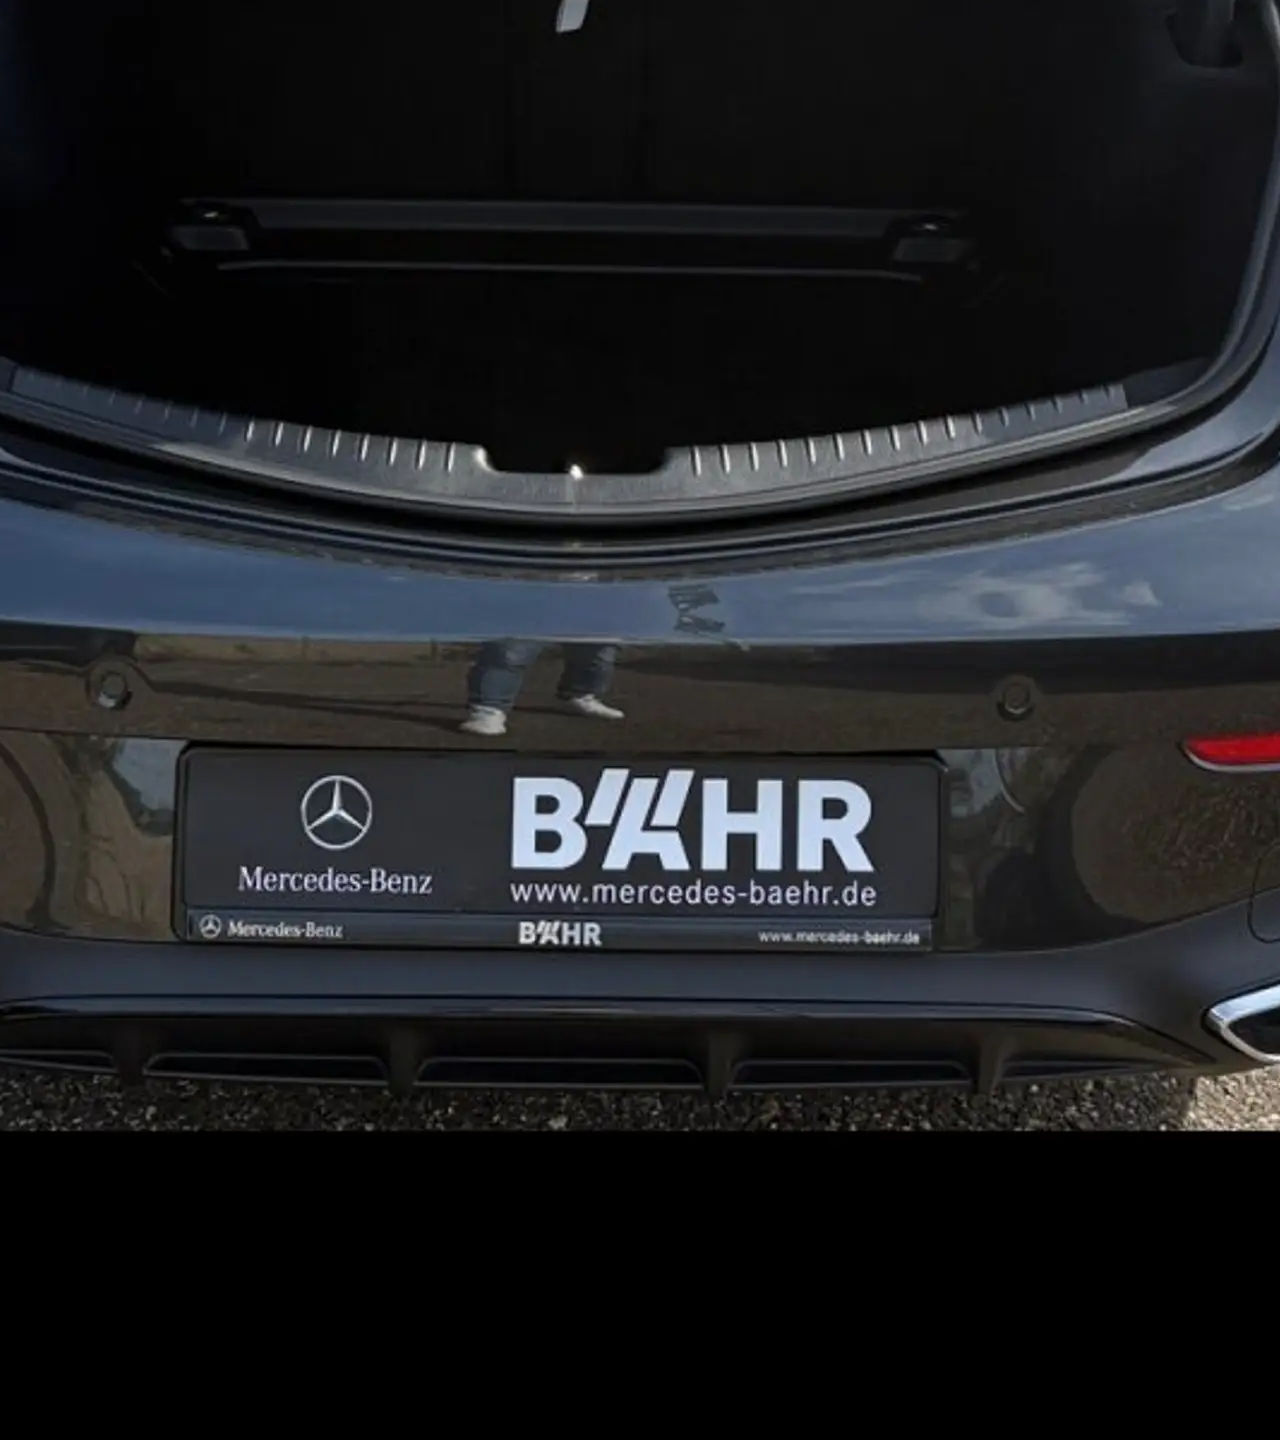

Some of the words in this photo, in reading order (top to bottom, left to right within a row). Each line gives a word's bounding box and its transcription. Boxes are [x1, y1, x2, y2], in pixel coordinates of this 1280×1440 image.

[511, 768, 875, 873] BÄHR
[237, 866, 433, 895] Mercedes-Benz
[510, 879, 877, 907] www.mercedes-baehr.de
[227, 919, 344, 939] Mercedes-Benz
